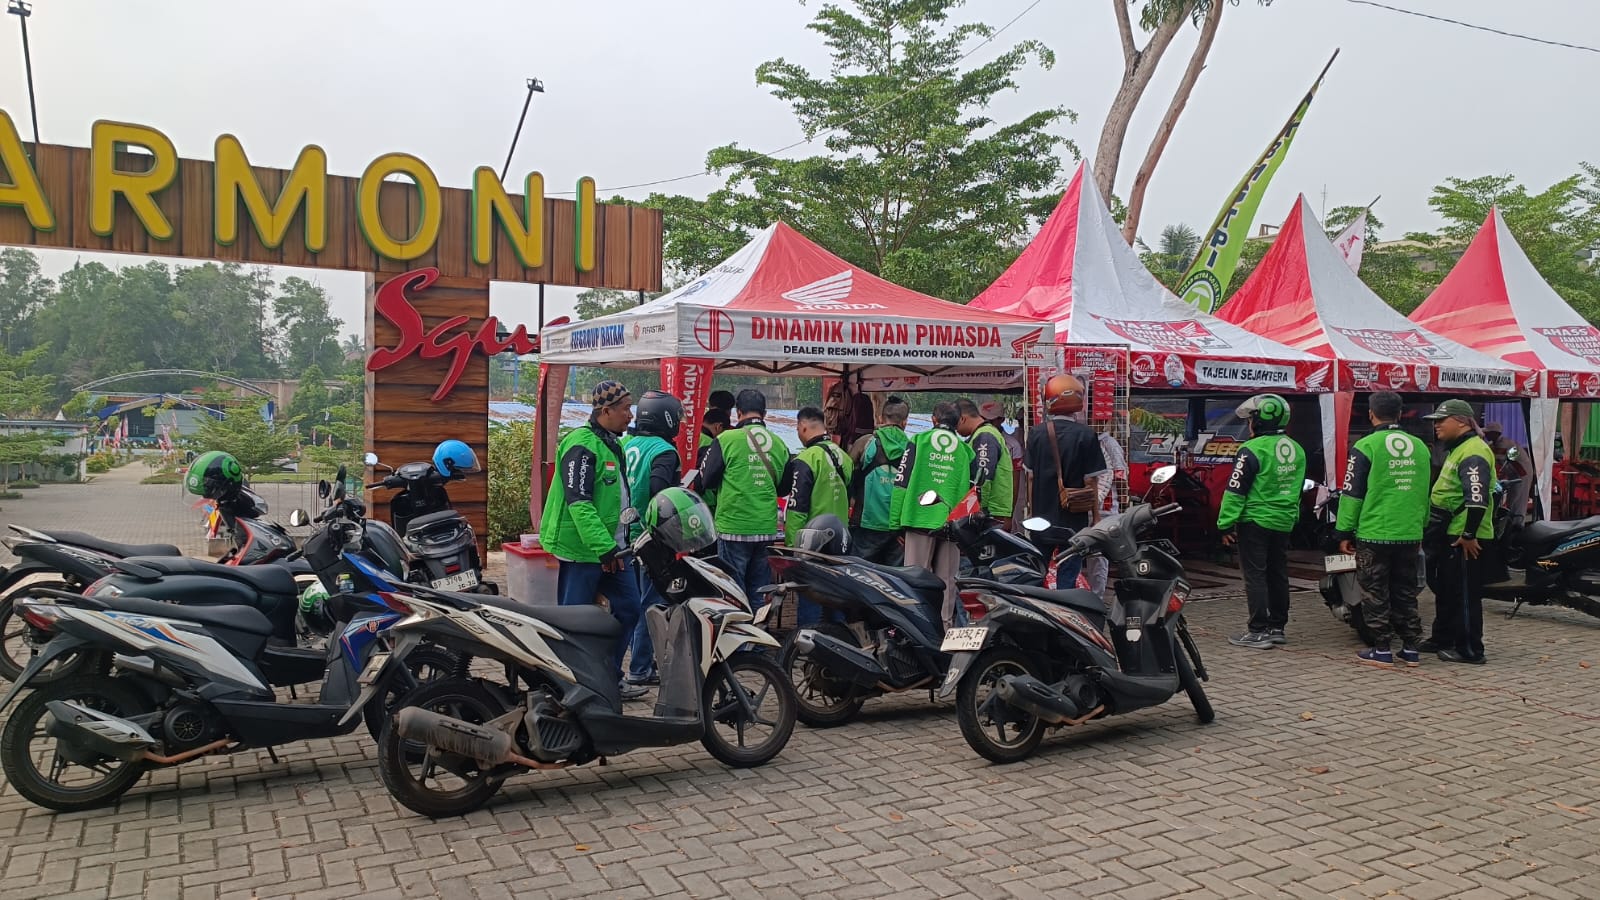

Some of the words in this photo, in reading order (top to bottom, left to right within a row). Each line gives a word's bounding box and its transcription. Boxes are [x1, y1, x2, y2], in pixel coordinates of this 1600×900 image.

[795, 303, 887, 311] HONDA
[600, 324, 625, 347] BATAM
[751, 316, 844, 343] DINAMIK
[850, 321, 909, 345] INTAN
[915, 324, 1002, 348] PIMASDA
[1342, 328, 1393, 340] AHASS
[1543, 328, 1588, 336] AHASS
[783, 345, 825, 355] DEALER
[827, 347, 859, 357] RESMI
[860, 348, 900, 358] SEPEDA
[902, 349, 938, 359] MOTOR
[941, 351, 975, 360] HONDA
[1011, 352, 1045, 360] HONDA
[1202, 366, 1239, 380] TAJELIN
[1240, 368, 1289, 383] SEJAHTERA
[894, 448, 911, 483] gojek
[929, 452, 956, 463] gojek
[977, 443, 989, 476] gojek
[1388, 457, 1416, 469] gojek
[1228, 453, 1249, 489] gojek
[1276, 462, 1297, 474] gojek
[1342, 454, 1358, 491] gojek
[1466, 465, 1483, 503] gojek
